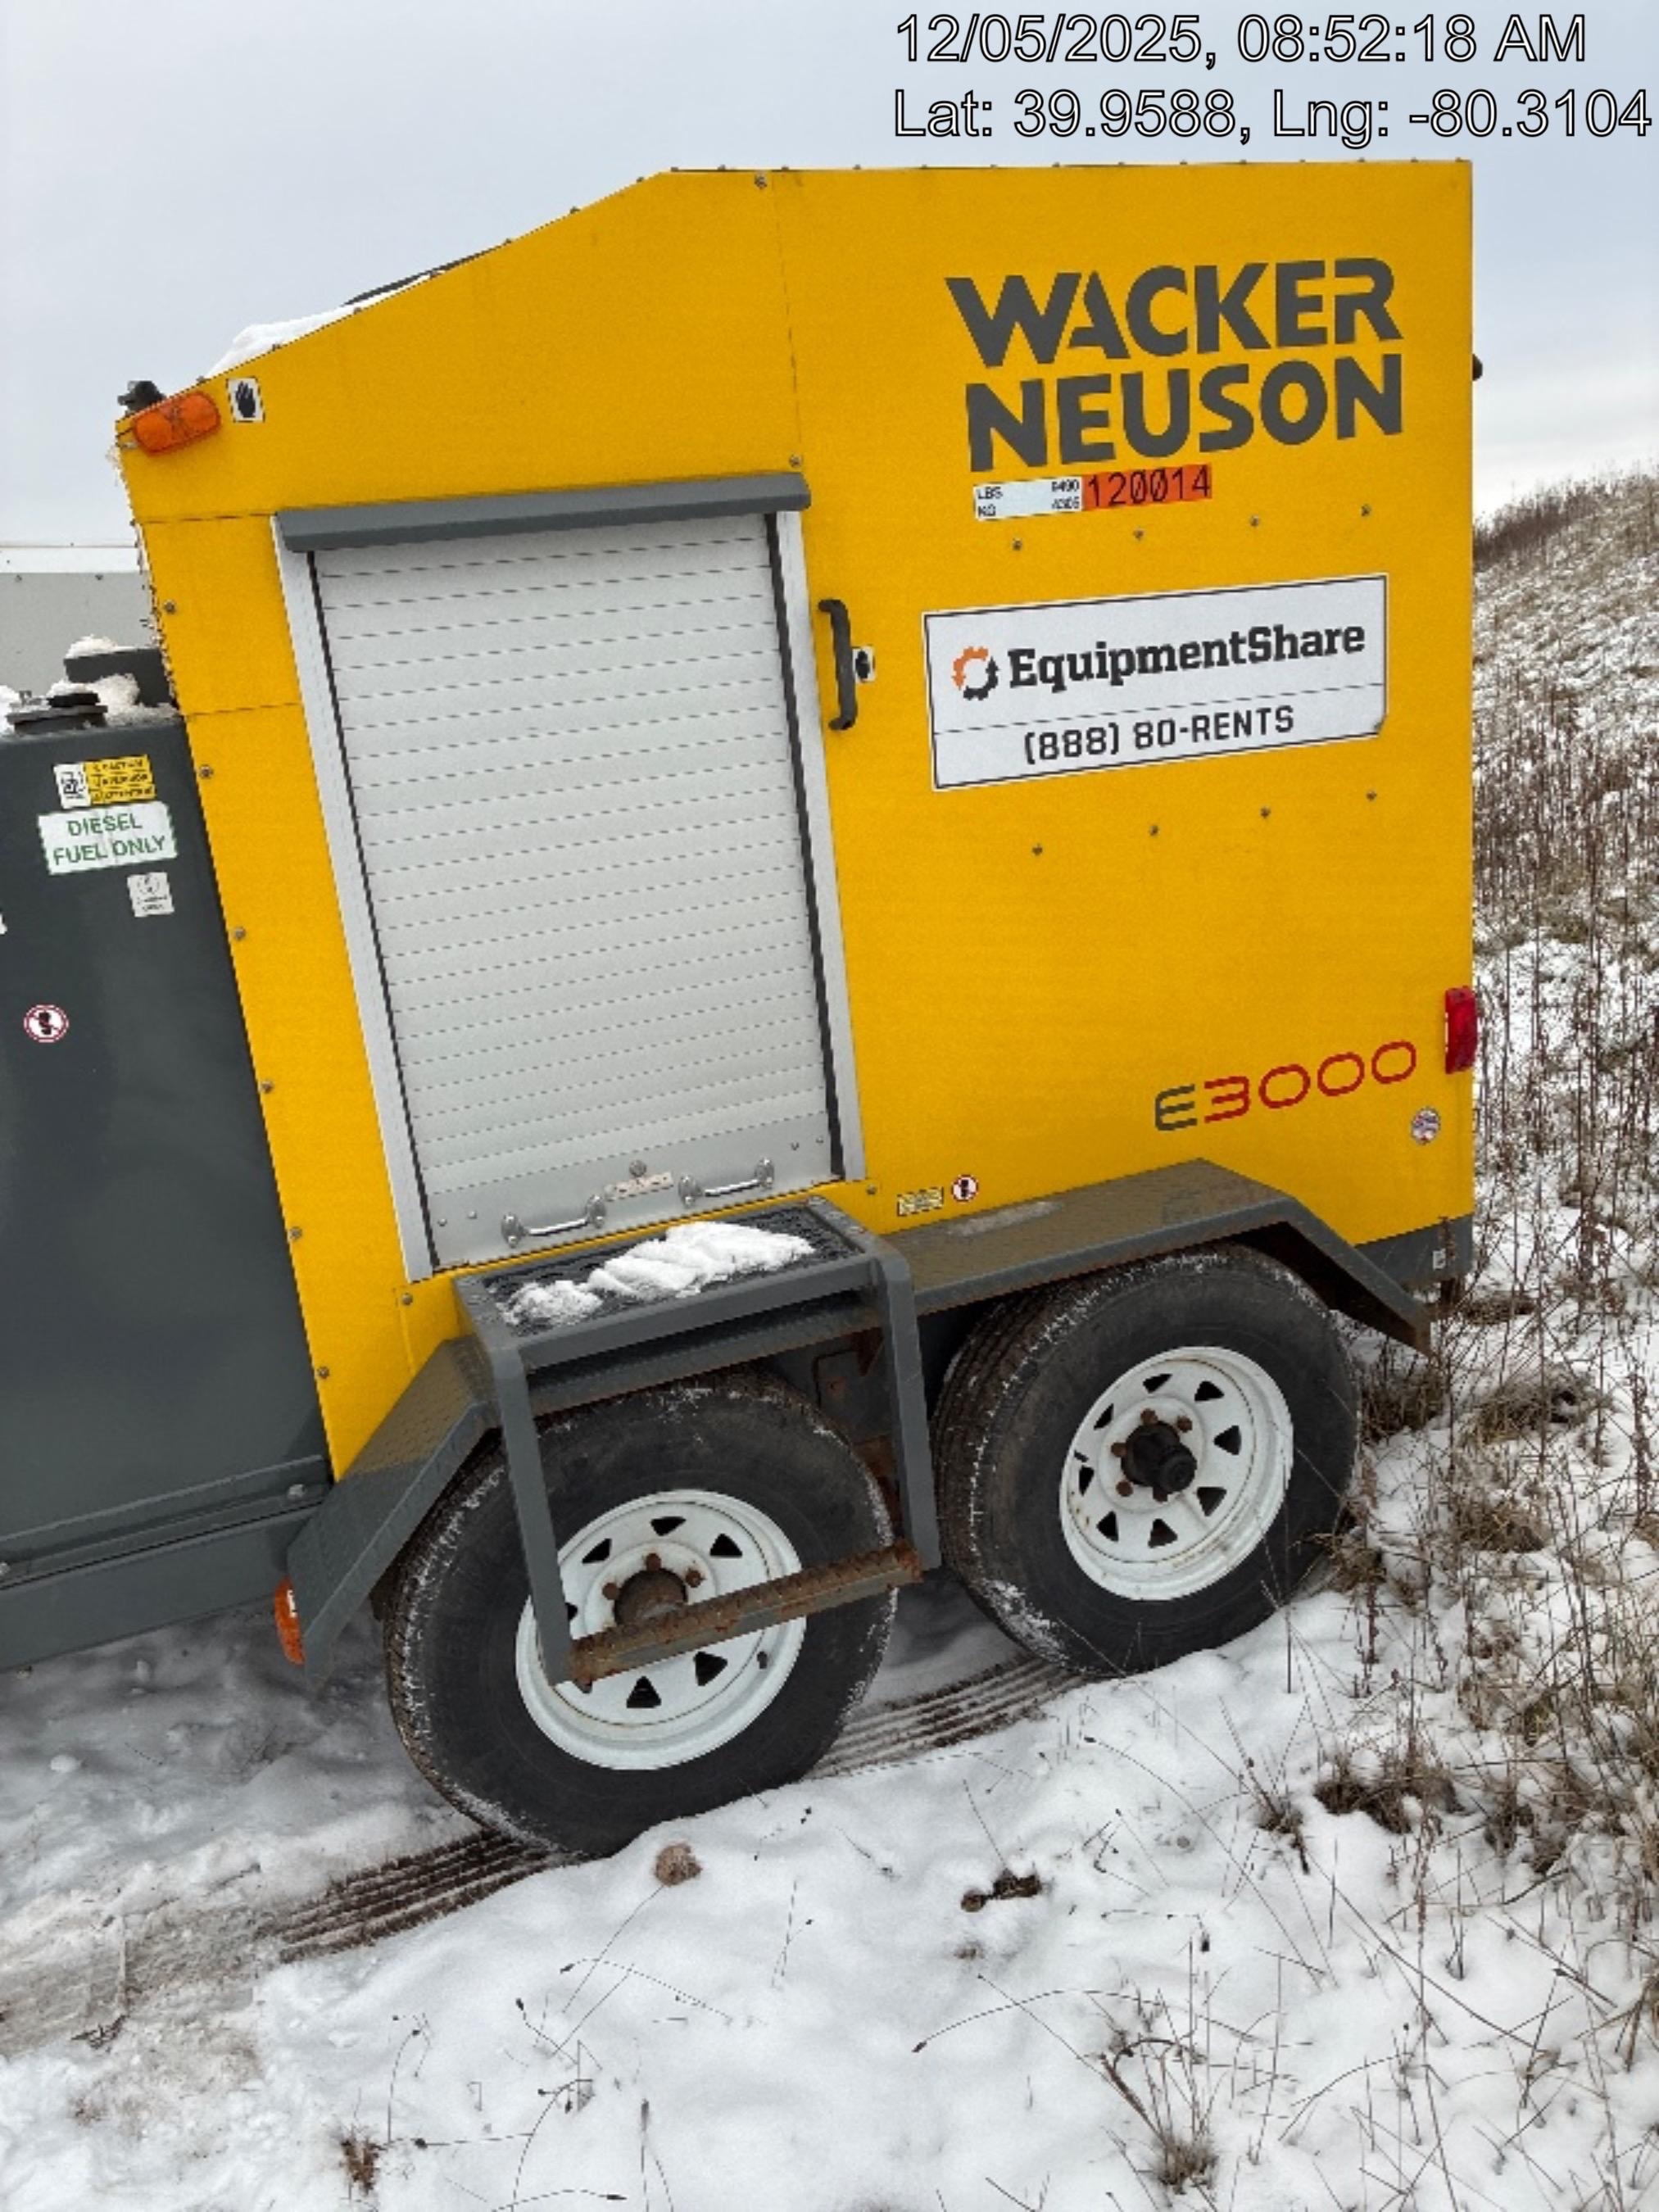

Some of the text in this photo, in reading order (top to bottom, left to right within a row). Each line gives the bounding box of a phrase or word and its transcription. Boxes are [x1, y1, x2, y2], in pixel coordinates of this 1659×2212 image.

[945, 257, 1403, 368] WACKER
[966, 353, 1403, 472] NEUSON
[977, 486, 1004, 500] LBS
[1088, 465, 1210, 507] 120014
[1008, 624, 1366, 693] EquipmentShare
[1024, 705, 1294, 765] (888) 80-RENTS
[52, 835, 165, 866] FUEL ONLY
[66, 813, 143, 836] DIESEL
[1154, 1040, 1417, 1131] E3000
